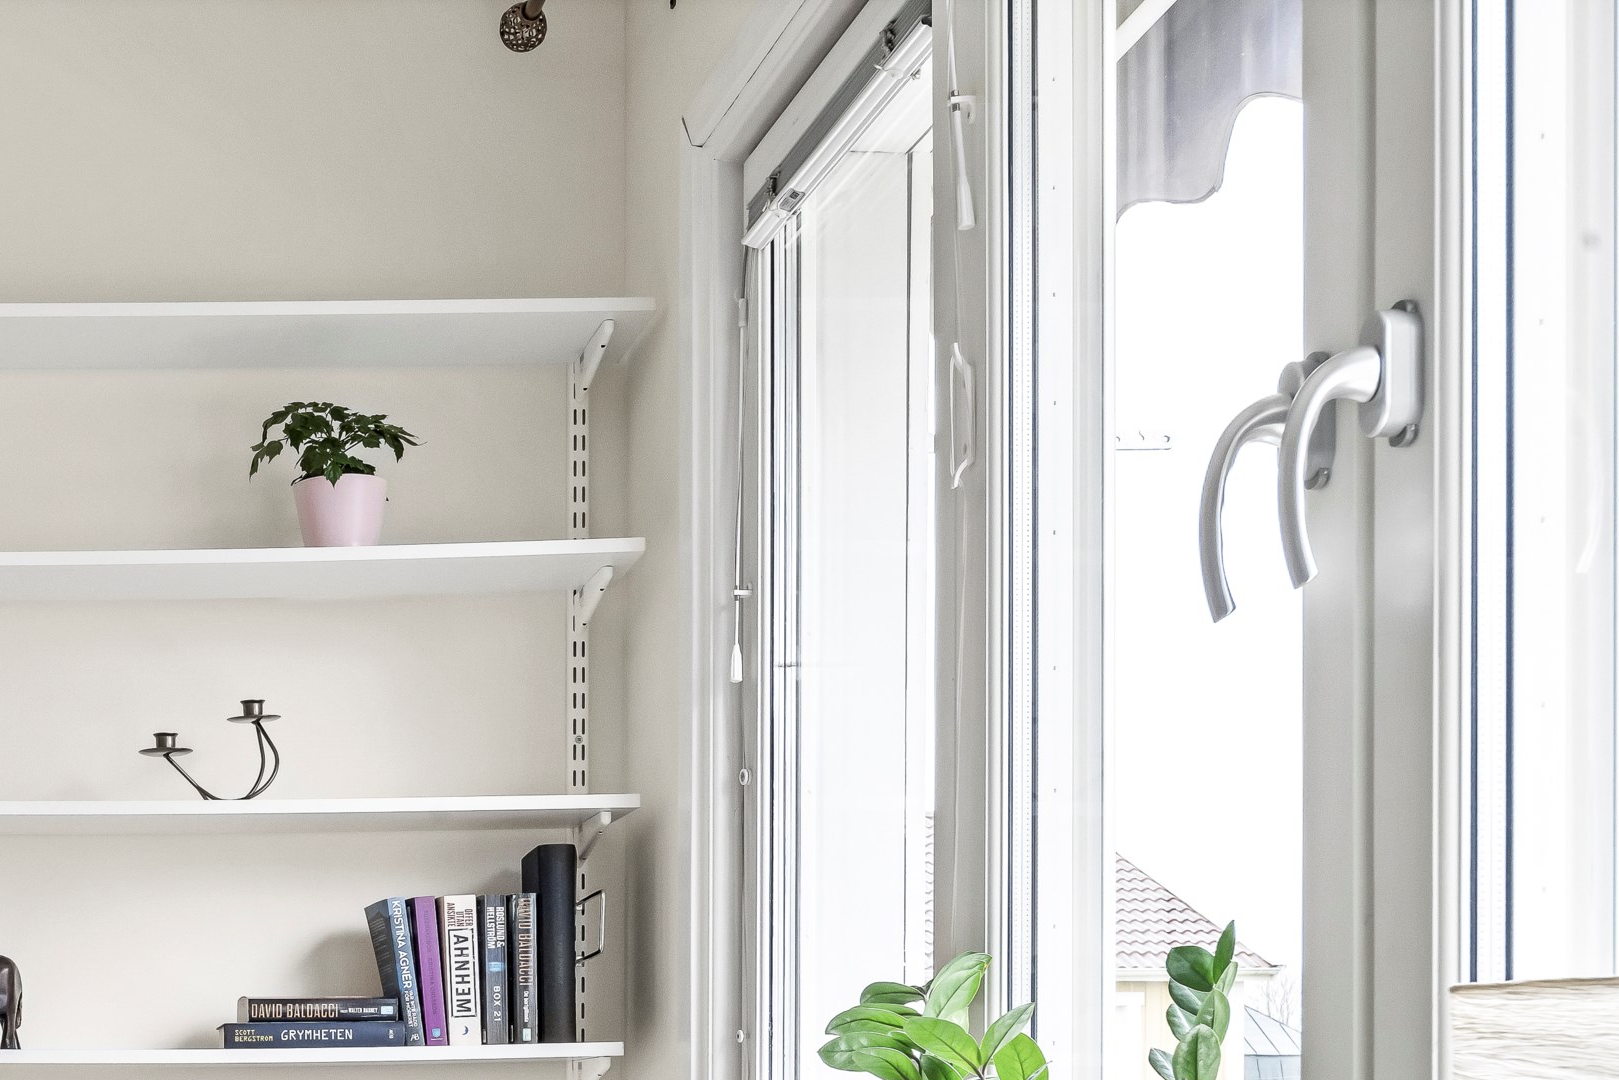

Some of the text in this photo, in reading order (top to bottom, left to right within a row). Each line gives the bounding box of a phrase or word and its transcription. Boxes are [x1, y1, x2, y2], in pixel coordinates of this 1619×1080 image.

[392, 900, 406, 948] KRISTINA
[446, 902, 456, 928] ANSIKTE
[455, 911, 465, 927] UTAN
[464, 908, 474, 927] OFFER
[486, 906, 497, 949] HELLSTRÖM
[495, 906, 505, 941] ROSLUND
[517, 896, 534, 986] DAVID BALDACCI
[453, 934, 472, 1013] AHNHEM
[251, 1003, 283, 1018] DAVID
[286, 1003, 338, 1018] BALDACCI
[493, 985, 502, 1022] BOX 21
[281, 1029, 353, 1041] GRYMHETEN
